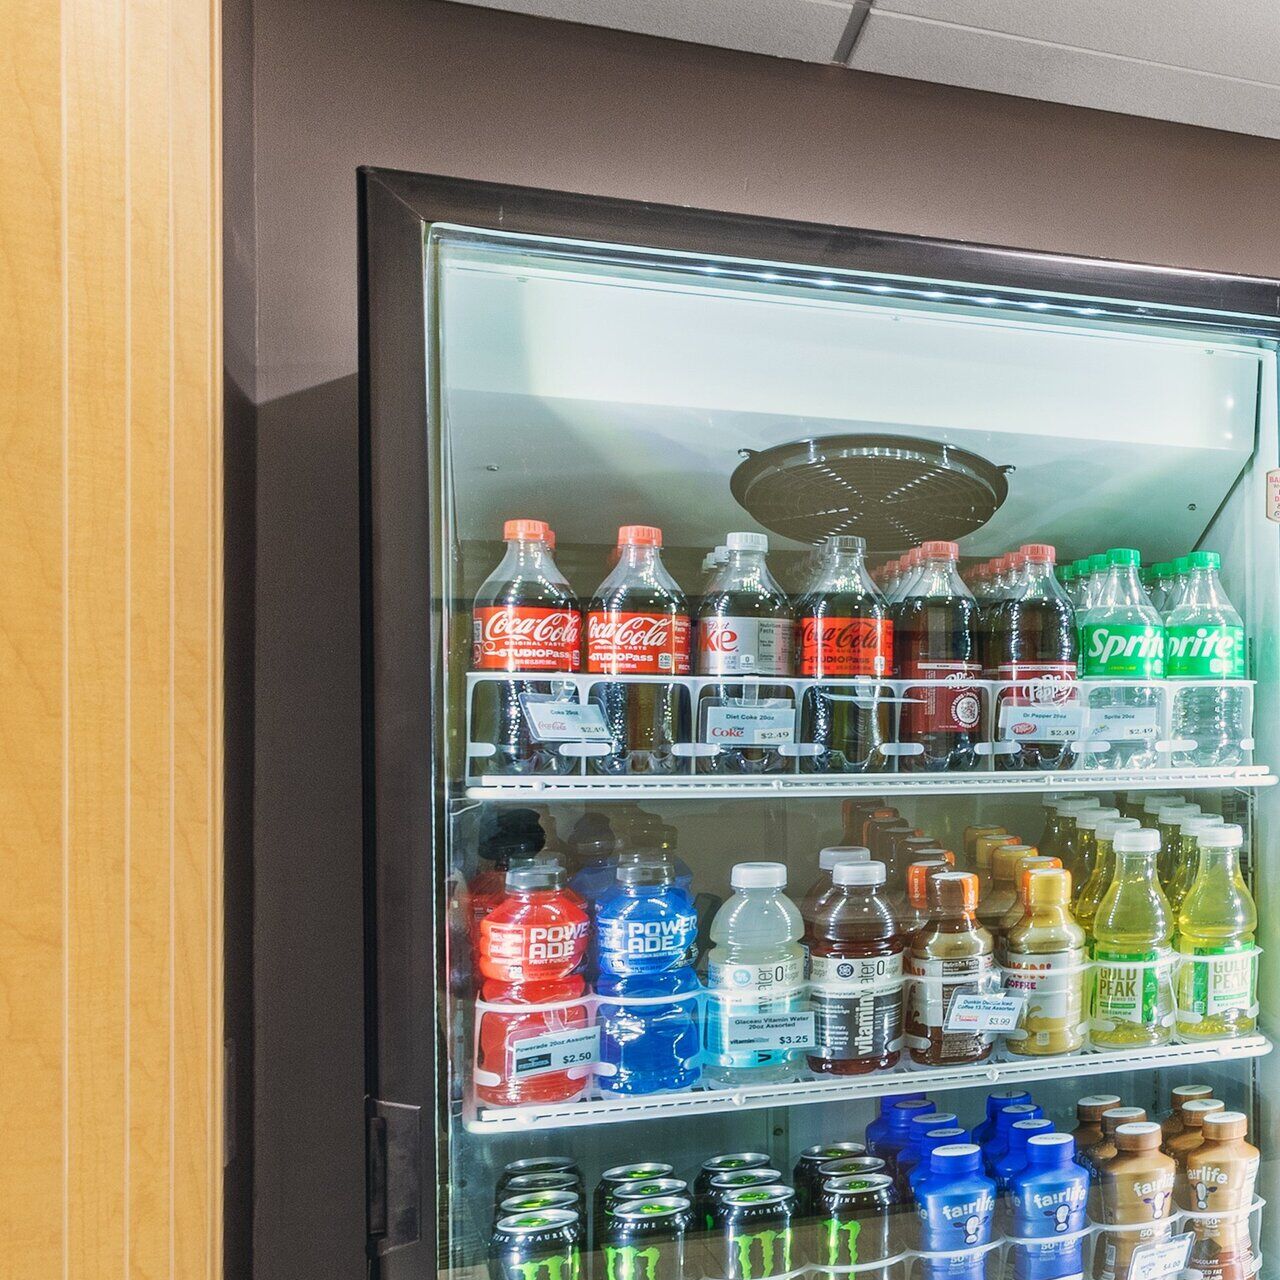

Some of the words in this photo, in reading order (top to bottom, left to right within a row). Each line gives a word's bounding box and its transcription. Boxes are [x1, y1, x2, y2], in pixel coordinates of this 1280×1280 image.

[485, 611, 581, 644] Coca-Cola
[712, 726, 745, 739] Coke
[760, 731, 790, 740] $2.49
[628, 915, 697, 937] POWER
[529, 942, 575, 960] ADE
[628, 935, 674, 953] ADE
[1100, 980, 1136, 999] PEAK
[989, 1017, 1011, 1026] $3.99
[779, 1036, 808, 1044] $3.25
[562, 1051, 592, 1065] $2.50
